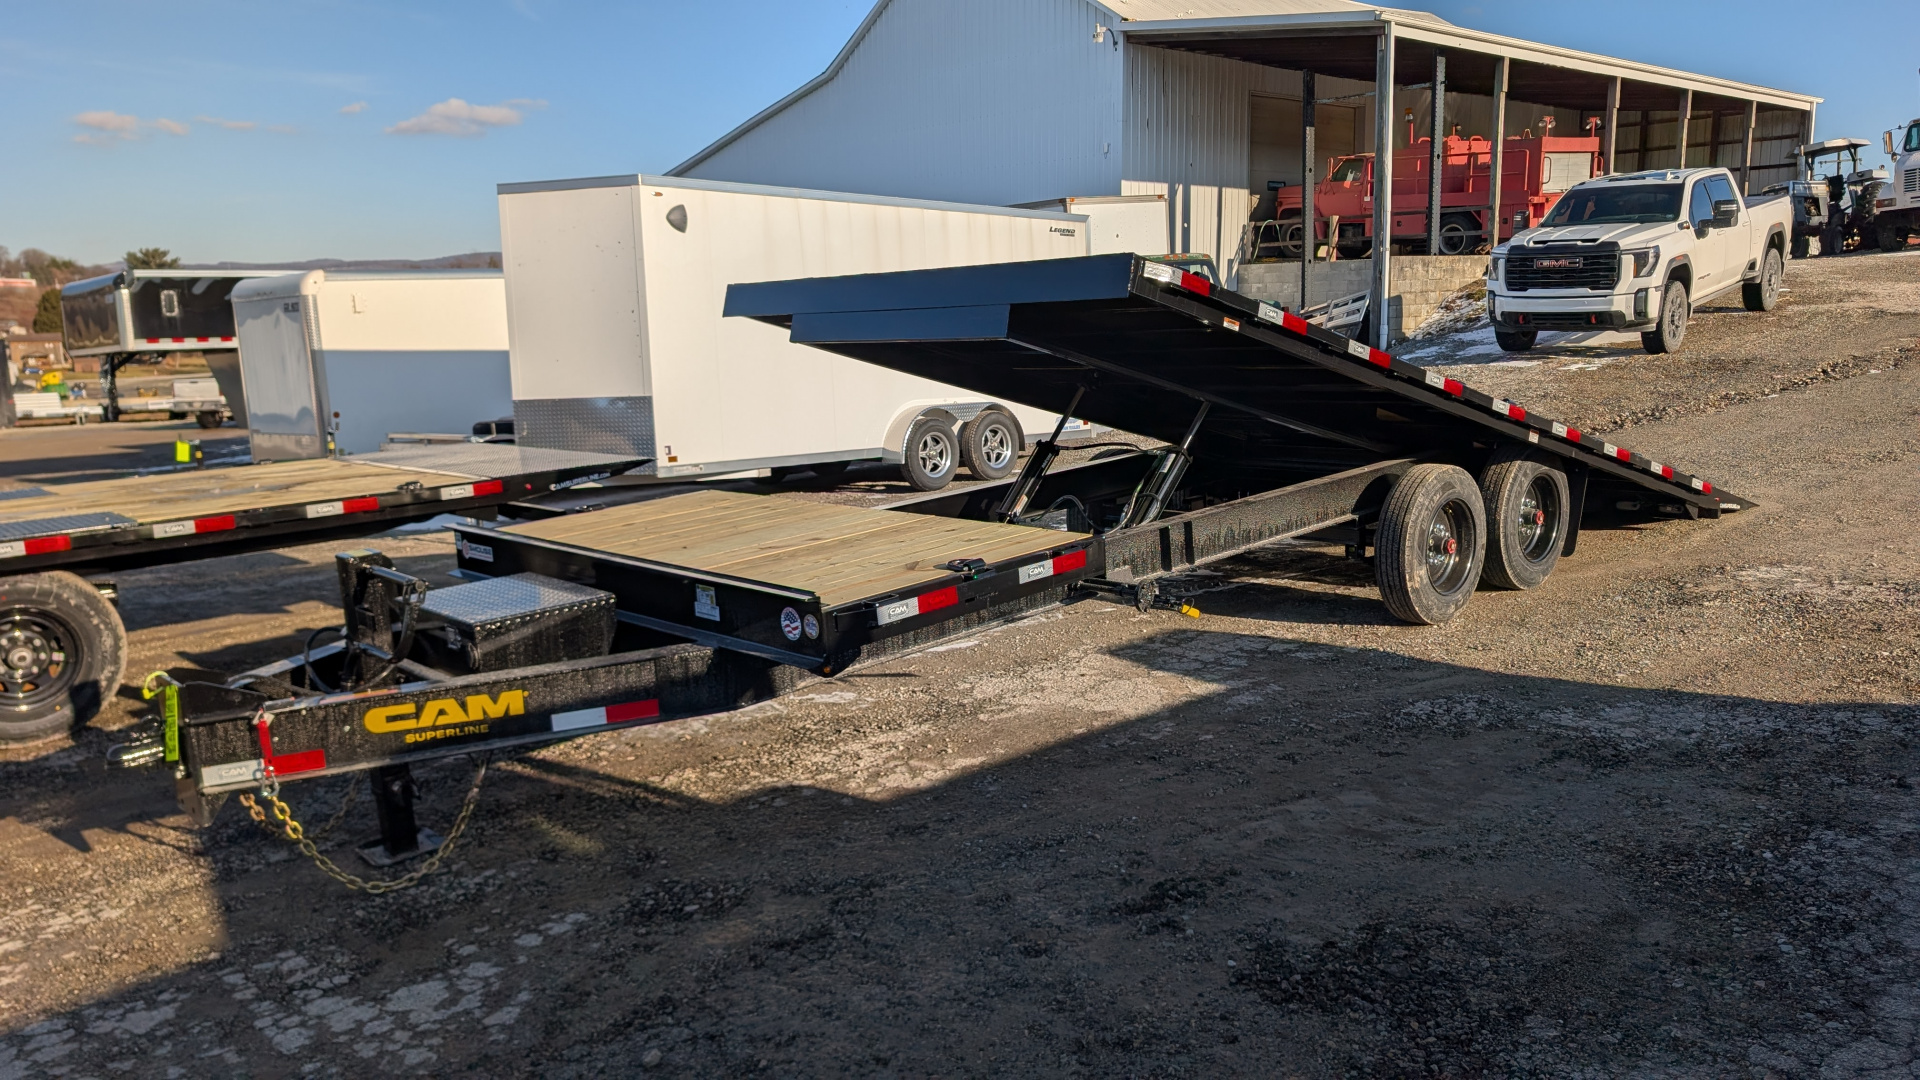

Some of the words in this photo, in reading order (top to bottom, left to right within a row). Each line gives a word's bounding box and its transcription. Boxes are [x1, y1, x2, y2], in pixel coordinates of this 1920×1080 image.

[1049, 226, 1076, 234] LEGEND
[1536, 259, 1580, 268] GMC
[1029, 566, 1044, 575] CAM
[889, 605, 907, 615] CAM
[364, 689, 525, 734] CAM
[405, 724, 489, 744] SUPERLINE
[221, 766, 248, 777] CAM
